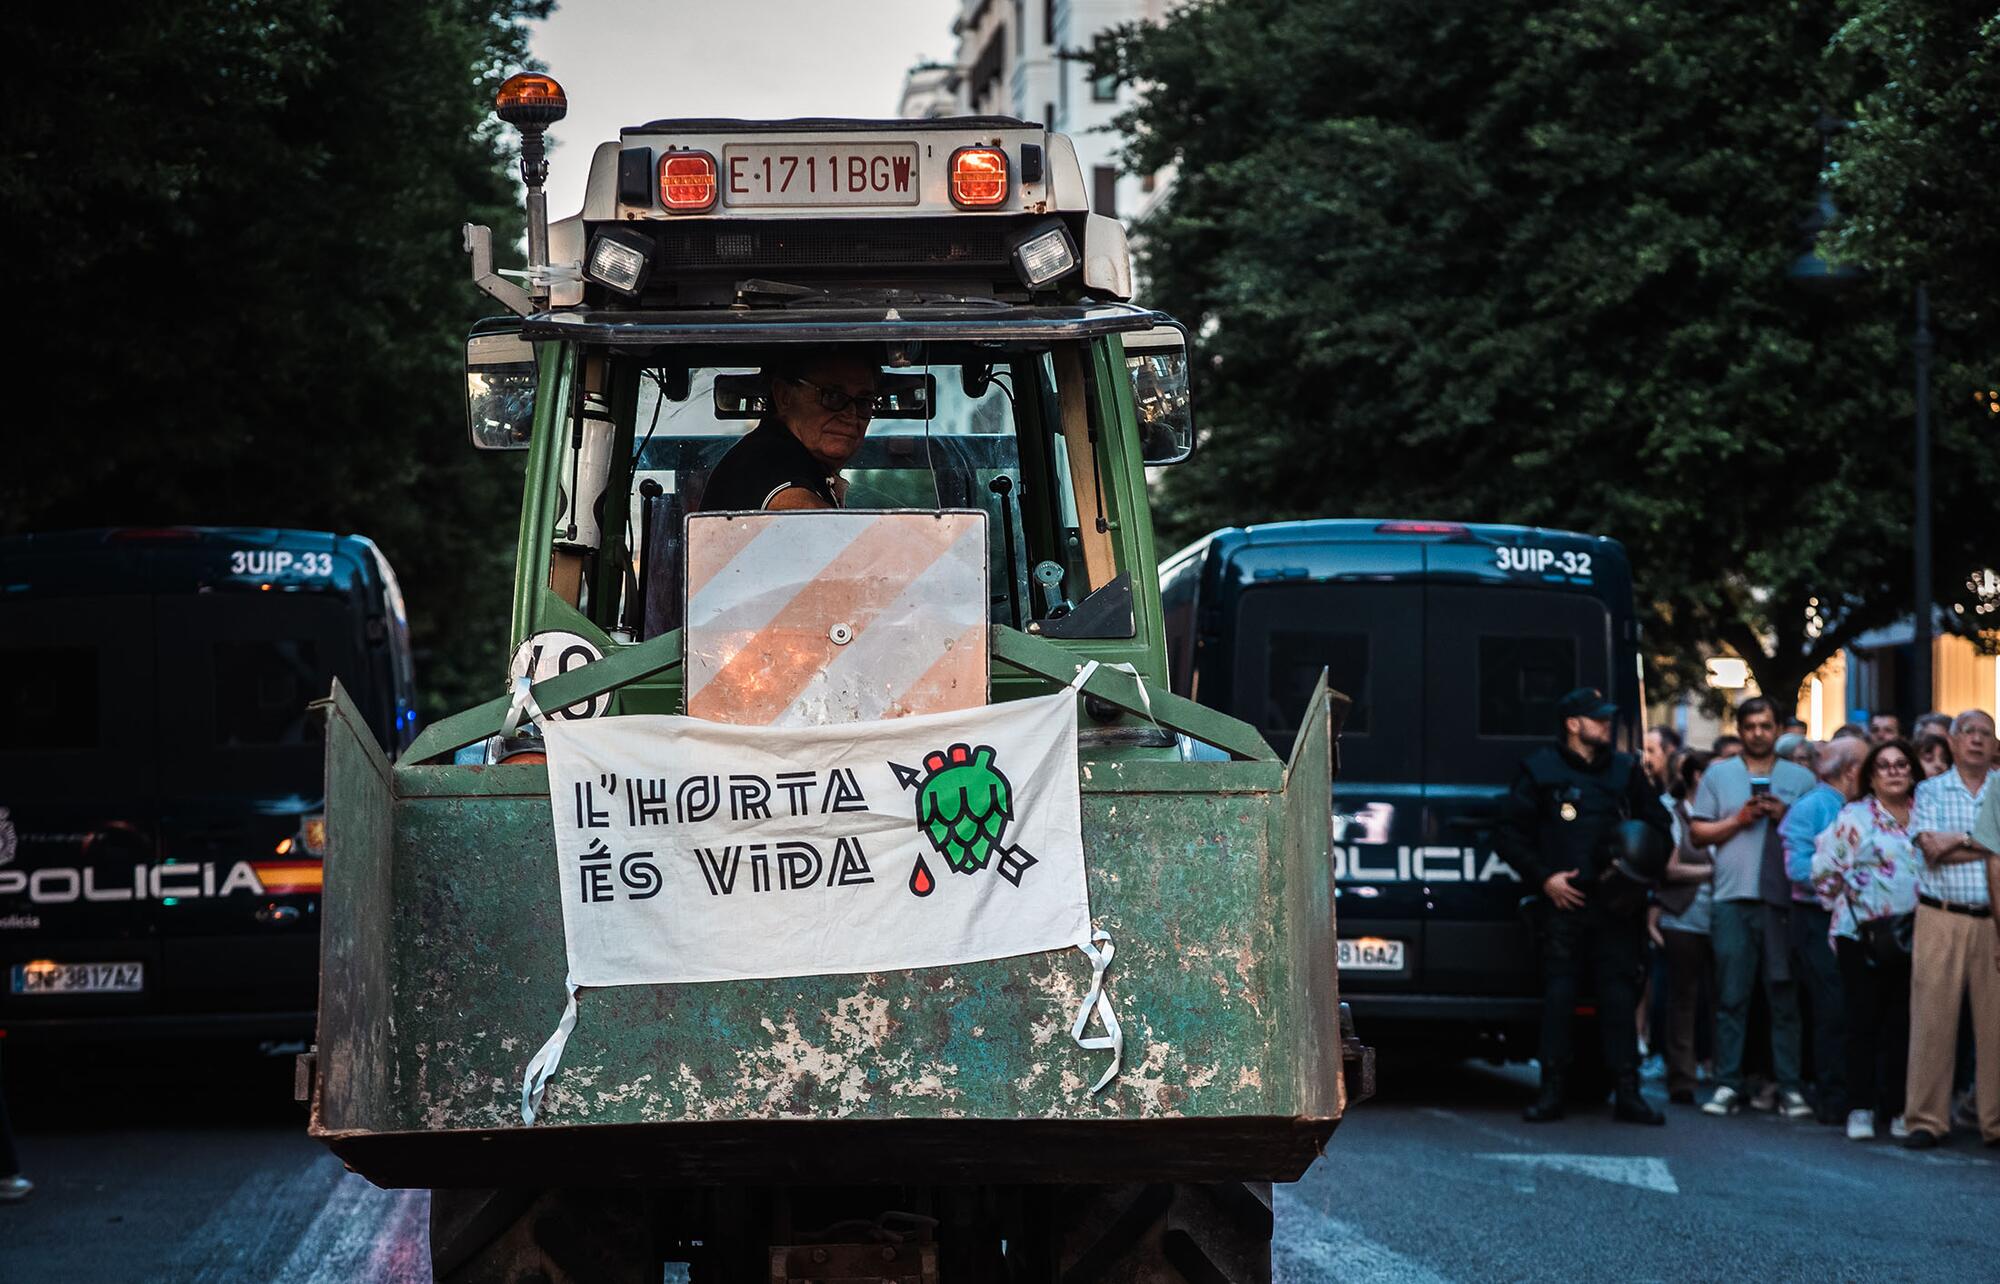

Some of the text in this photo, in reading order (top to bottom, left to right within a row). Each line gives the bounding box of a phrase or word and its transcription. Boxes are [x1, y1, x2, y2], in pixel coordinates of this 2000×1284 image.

[230, 550, 333, 576] 3UIP-33
[1496, 546, 1592, 575] 3UIP-32
[575, 767, 869, 829] L'HORTA
[579, 837, 663, 903] ÉS
[1334, 845, 1522, 882] LICIA
[1339, 942, 1399, 965] 816AZ
